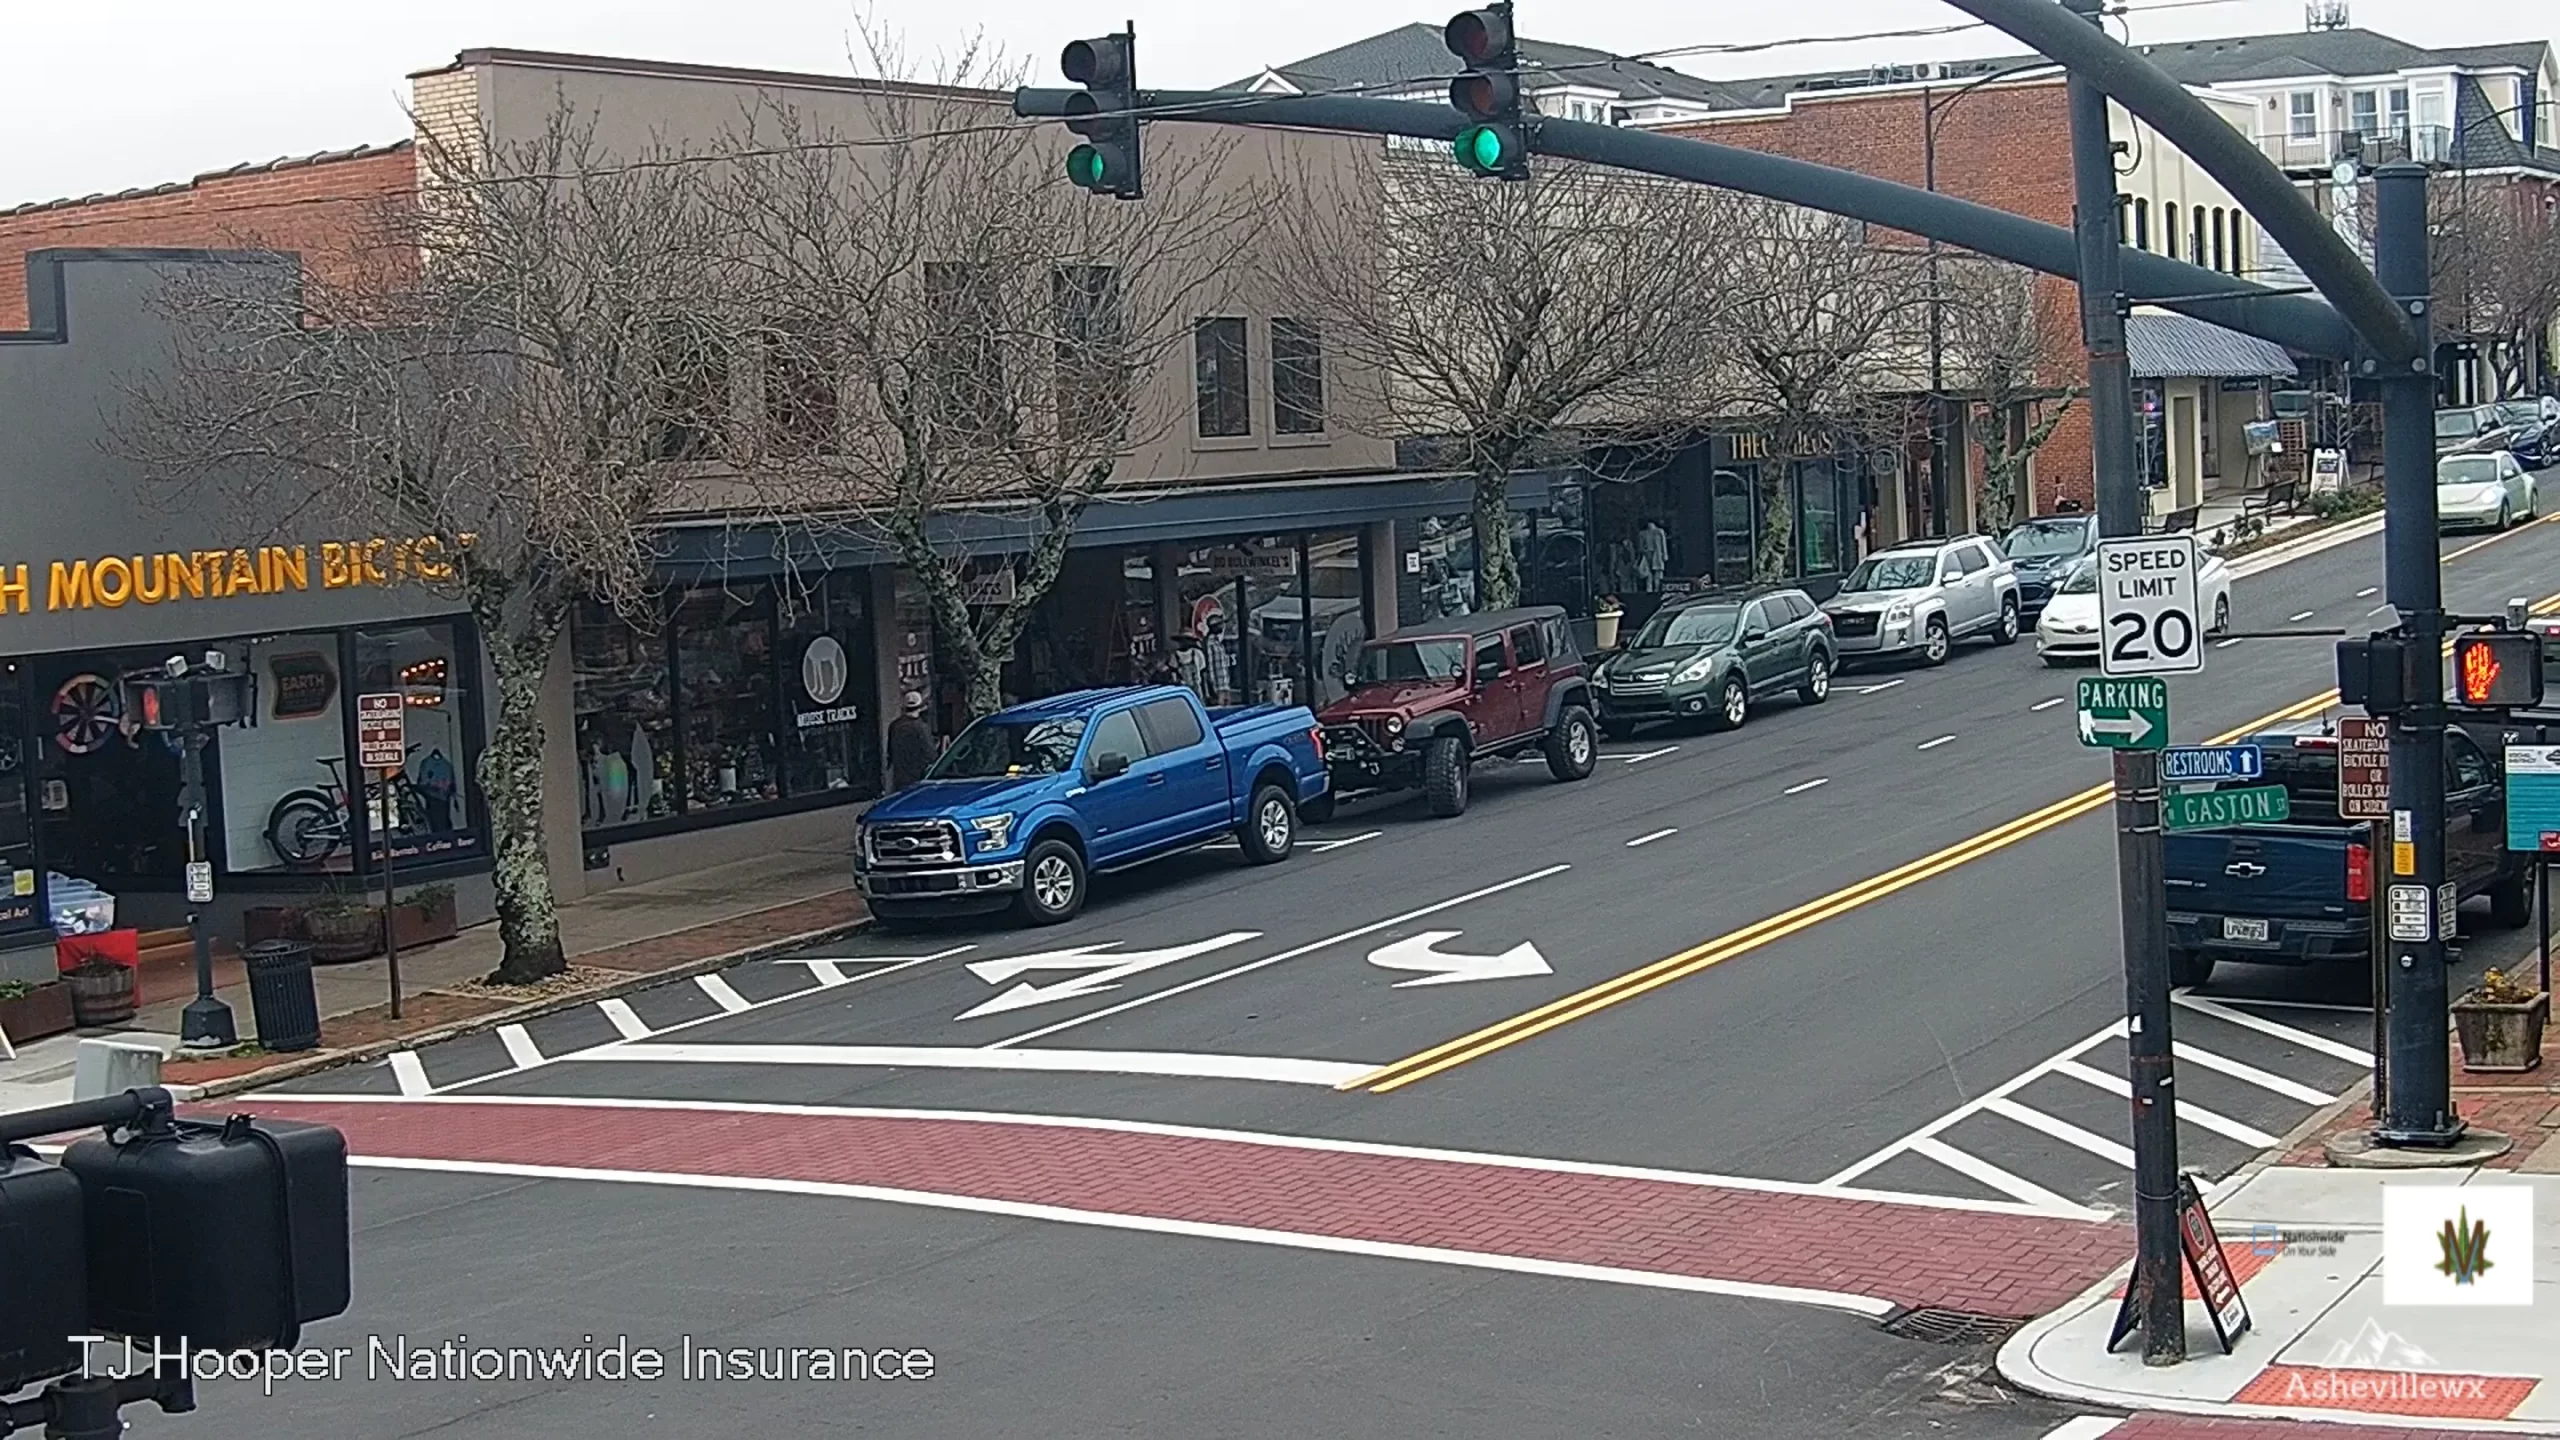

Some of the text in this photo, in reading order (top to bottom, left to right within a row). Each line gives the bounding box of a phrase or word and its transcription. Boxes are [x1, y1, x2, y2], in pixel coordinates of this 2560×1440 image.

[2108, 549, 2186, 573] SPEED
[48, 542, 307, 612] MOUNTAIN
[2118, 576, 2177, 599] LIMIT
[2109, 609, 2193, 661] 20
[281, 673, 325, 691] EARTH
[2079, 682, 2165, 709] PARKING
[2364, 722, 2386, 738] NO
[2166, 750, 2233, 776] RESTROOMS
[2343, 753, 2378, 767] BICYCLE
[2369, 769, 2382, 782] OR
[2342, 784, 2373, 798] ROLLER
[2184, 791, 2270, 823] GASTON
